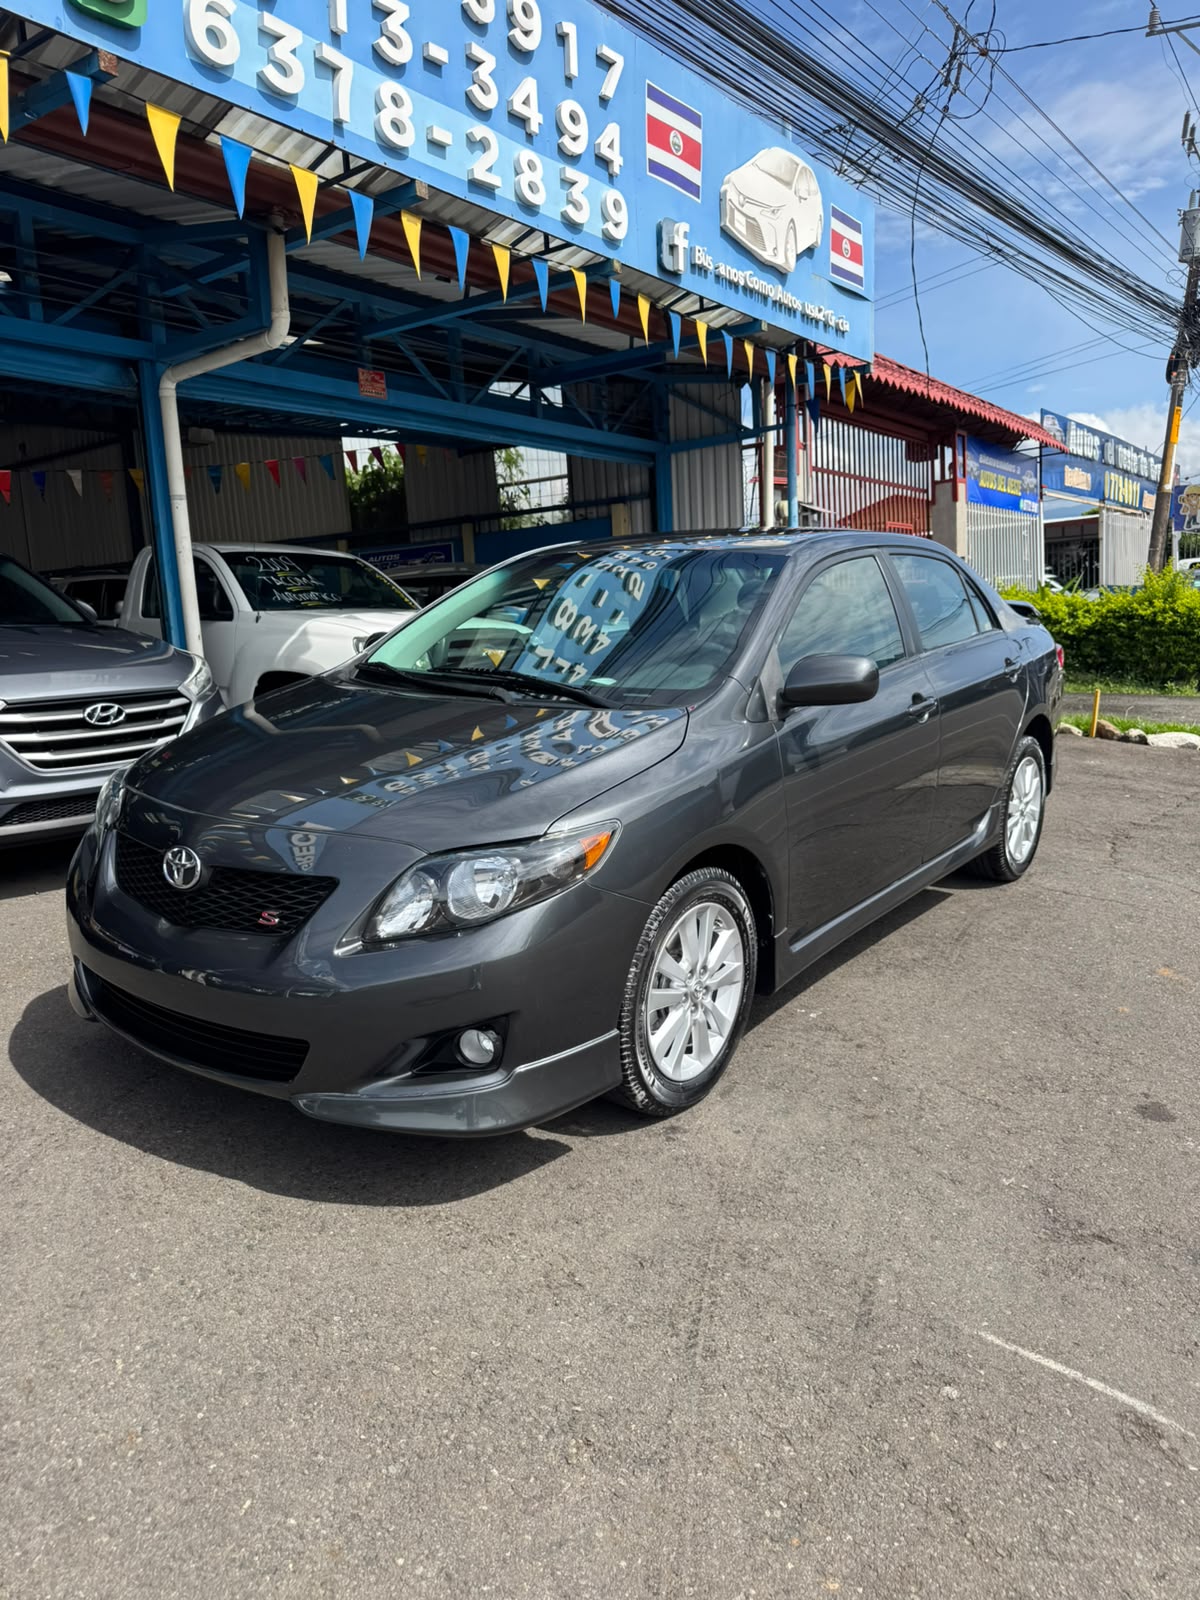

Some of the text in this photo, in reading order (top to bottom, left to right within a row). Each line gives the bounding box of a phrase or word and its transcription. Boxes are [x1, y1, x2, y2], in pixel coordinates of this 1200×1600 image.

[184, 0, 629, 241] 6378-2839
[245, 555, 305, 574] 2009
[368, 553, 401, 563] AUTOS
